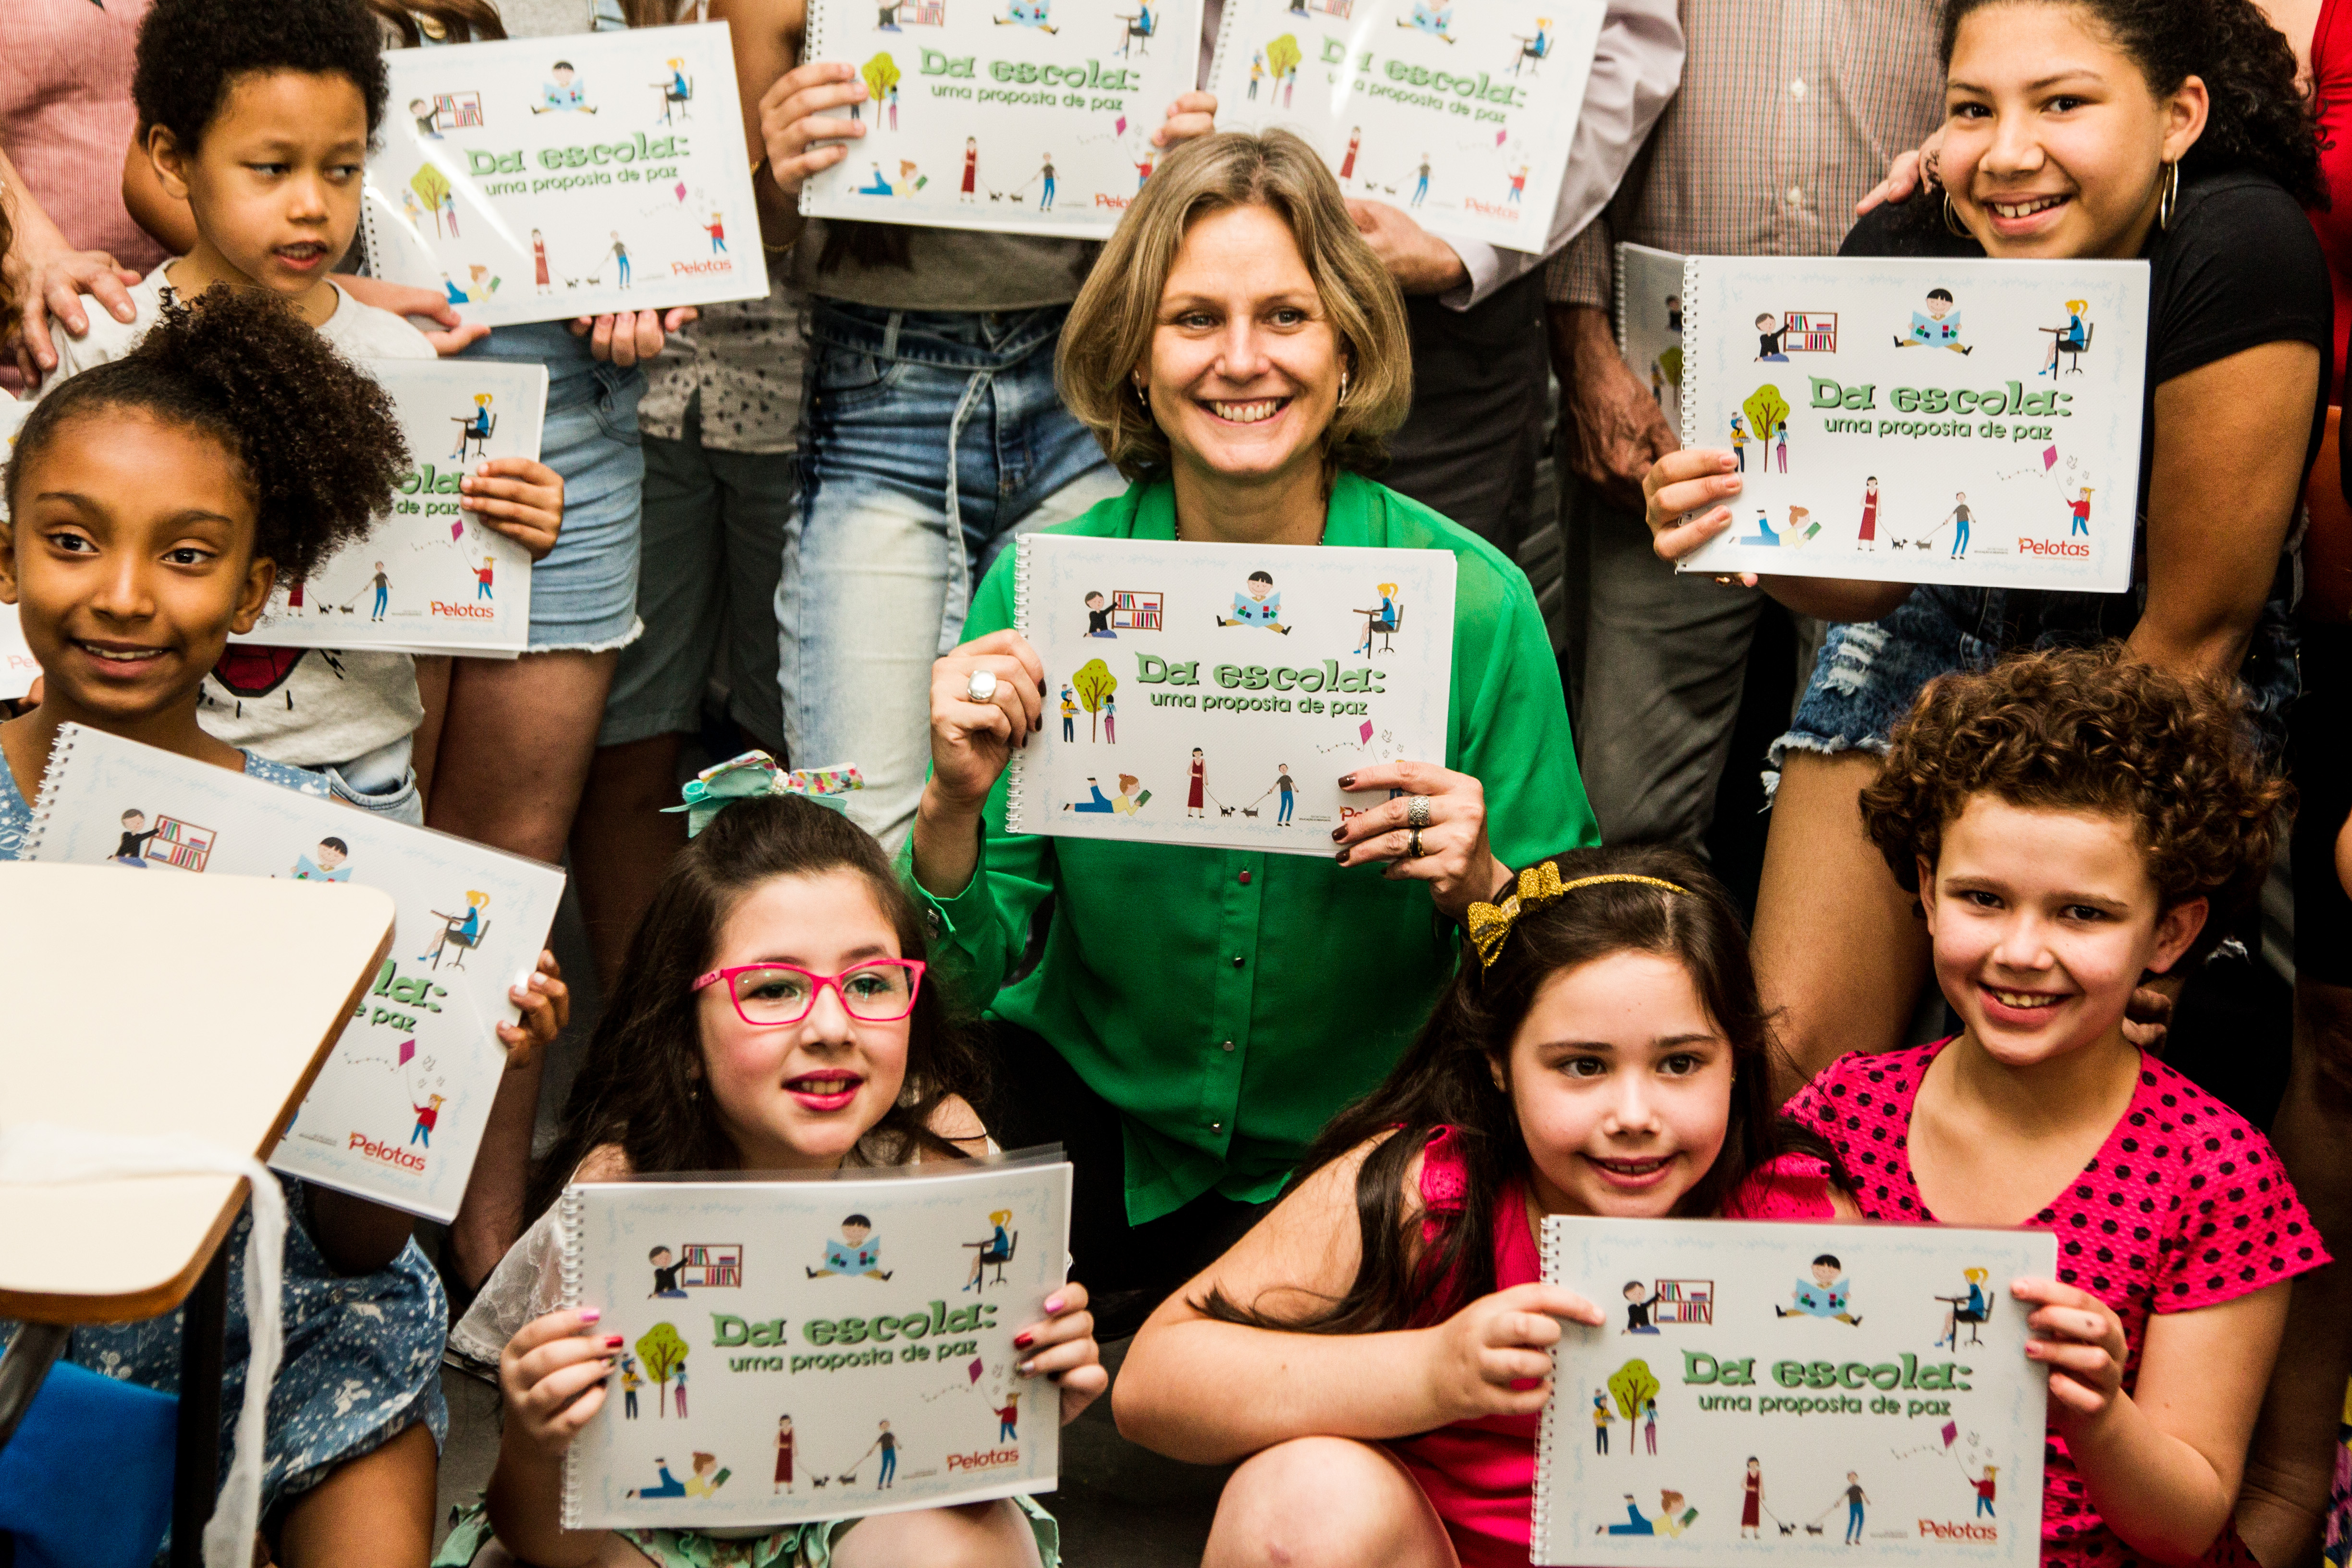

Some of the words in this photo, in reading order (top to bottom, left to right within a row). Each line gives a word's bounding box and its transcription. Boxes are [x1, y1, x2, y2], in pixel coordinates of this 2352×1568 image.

[919, 46, 975, 78] Da
[989, 58, 1140, 91] escola:
[1384, 59, 1526, 107] escola:
[931, 85, 971, 98] uma
[978, 87, 1056, 105] proposta
[1063, 92, 1085, 108] de
[1091, 97, 1123, 111] paz
[1370, 83, 1442, 110] proposta
[1449, 101, 1470, 115] de
[1475, 108, 1506, 123] paz
[464, 148, 526, 176] Da
[537, 131, 689, 169] escola:
[484, 181, 527, 196] uma
[533, 171, 611, 193] proposta
[618, 169, 639, 182] de
[646, 166, 678, 182] paz
[671, 259, 731, 276] Pelotas
[1808, 375, 1876, 411] Da
[1890, 380, 2073, 417] escola:
[1825, 417, 1872, 434] uma
[1878, 419, 1971, 439] proposta
[1978, 420, 2007, 438] de
[2012, 423, 2052, 442] paz
[395, 498, 420, 514] de
[425, 502, 459, 517] paz
[2019, 537, 2089, 556] Pelotas
[431, 600, 494, 617] Pelotas
[1135, 651, 1200, 686] Da
[1213, 659, 1385, 694] escola:
[1150, 693, 1196, 708] uma
[1202, 695, 1291, 713] proposta
[1297, 697, 1324, 713] de
[1330, 699, 1368, 717] paz
[370, 1006, 417, 1033] paz
[348, 1131, 426, 1171] Pelotas
[710, 1311, 787, 1347] Da
[803, 1300, 997, 1346] escola:
[729, 1355, 783, 1372] uma
[791, 1347, 893, 1374] proposta
[901, 1343, 930, 1362] de
[937, 1339, 978, 1362] paz
[1681, 1349, 1756, 1386] Da
[1771, 1352, 1972, 1391] escola:
[1698, 1395, 1752, 1413] uma
[1759, 1394, 1862, 1416] proposta
[1869, 1395, 1900, 1415] de
[1907, 1398, 1950, 1419] paz
[947, 1449, 1019, 1471] Pelotas
[1919, 1519, 1997, 1540] Pelotas
